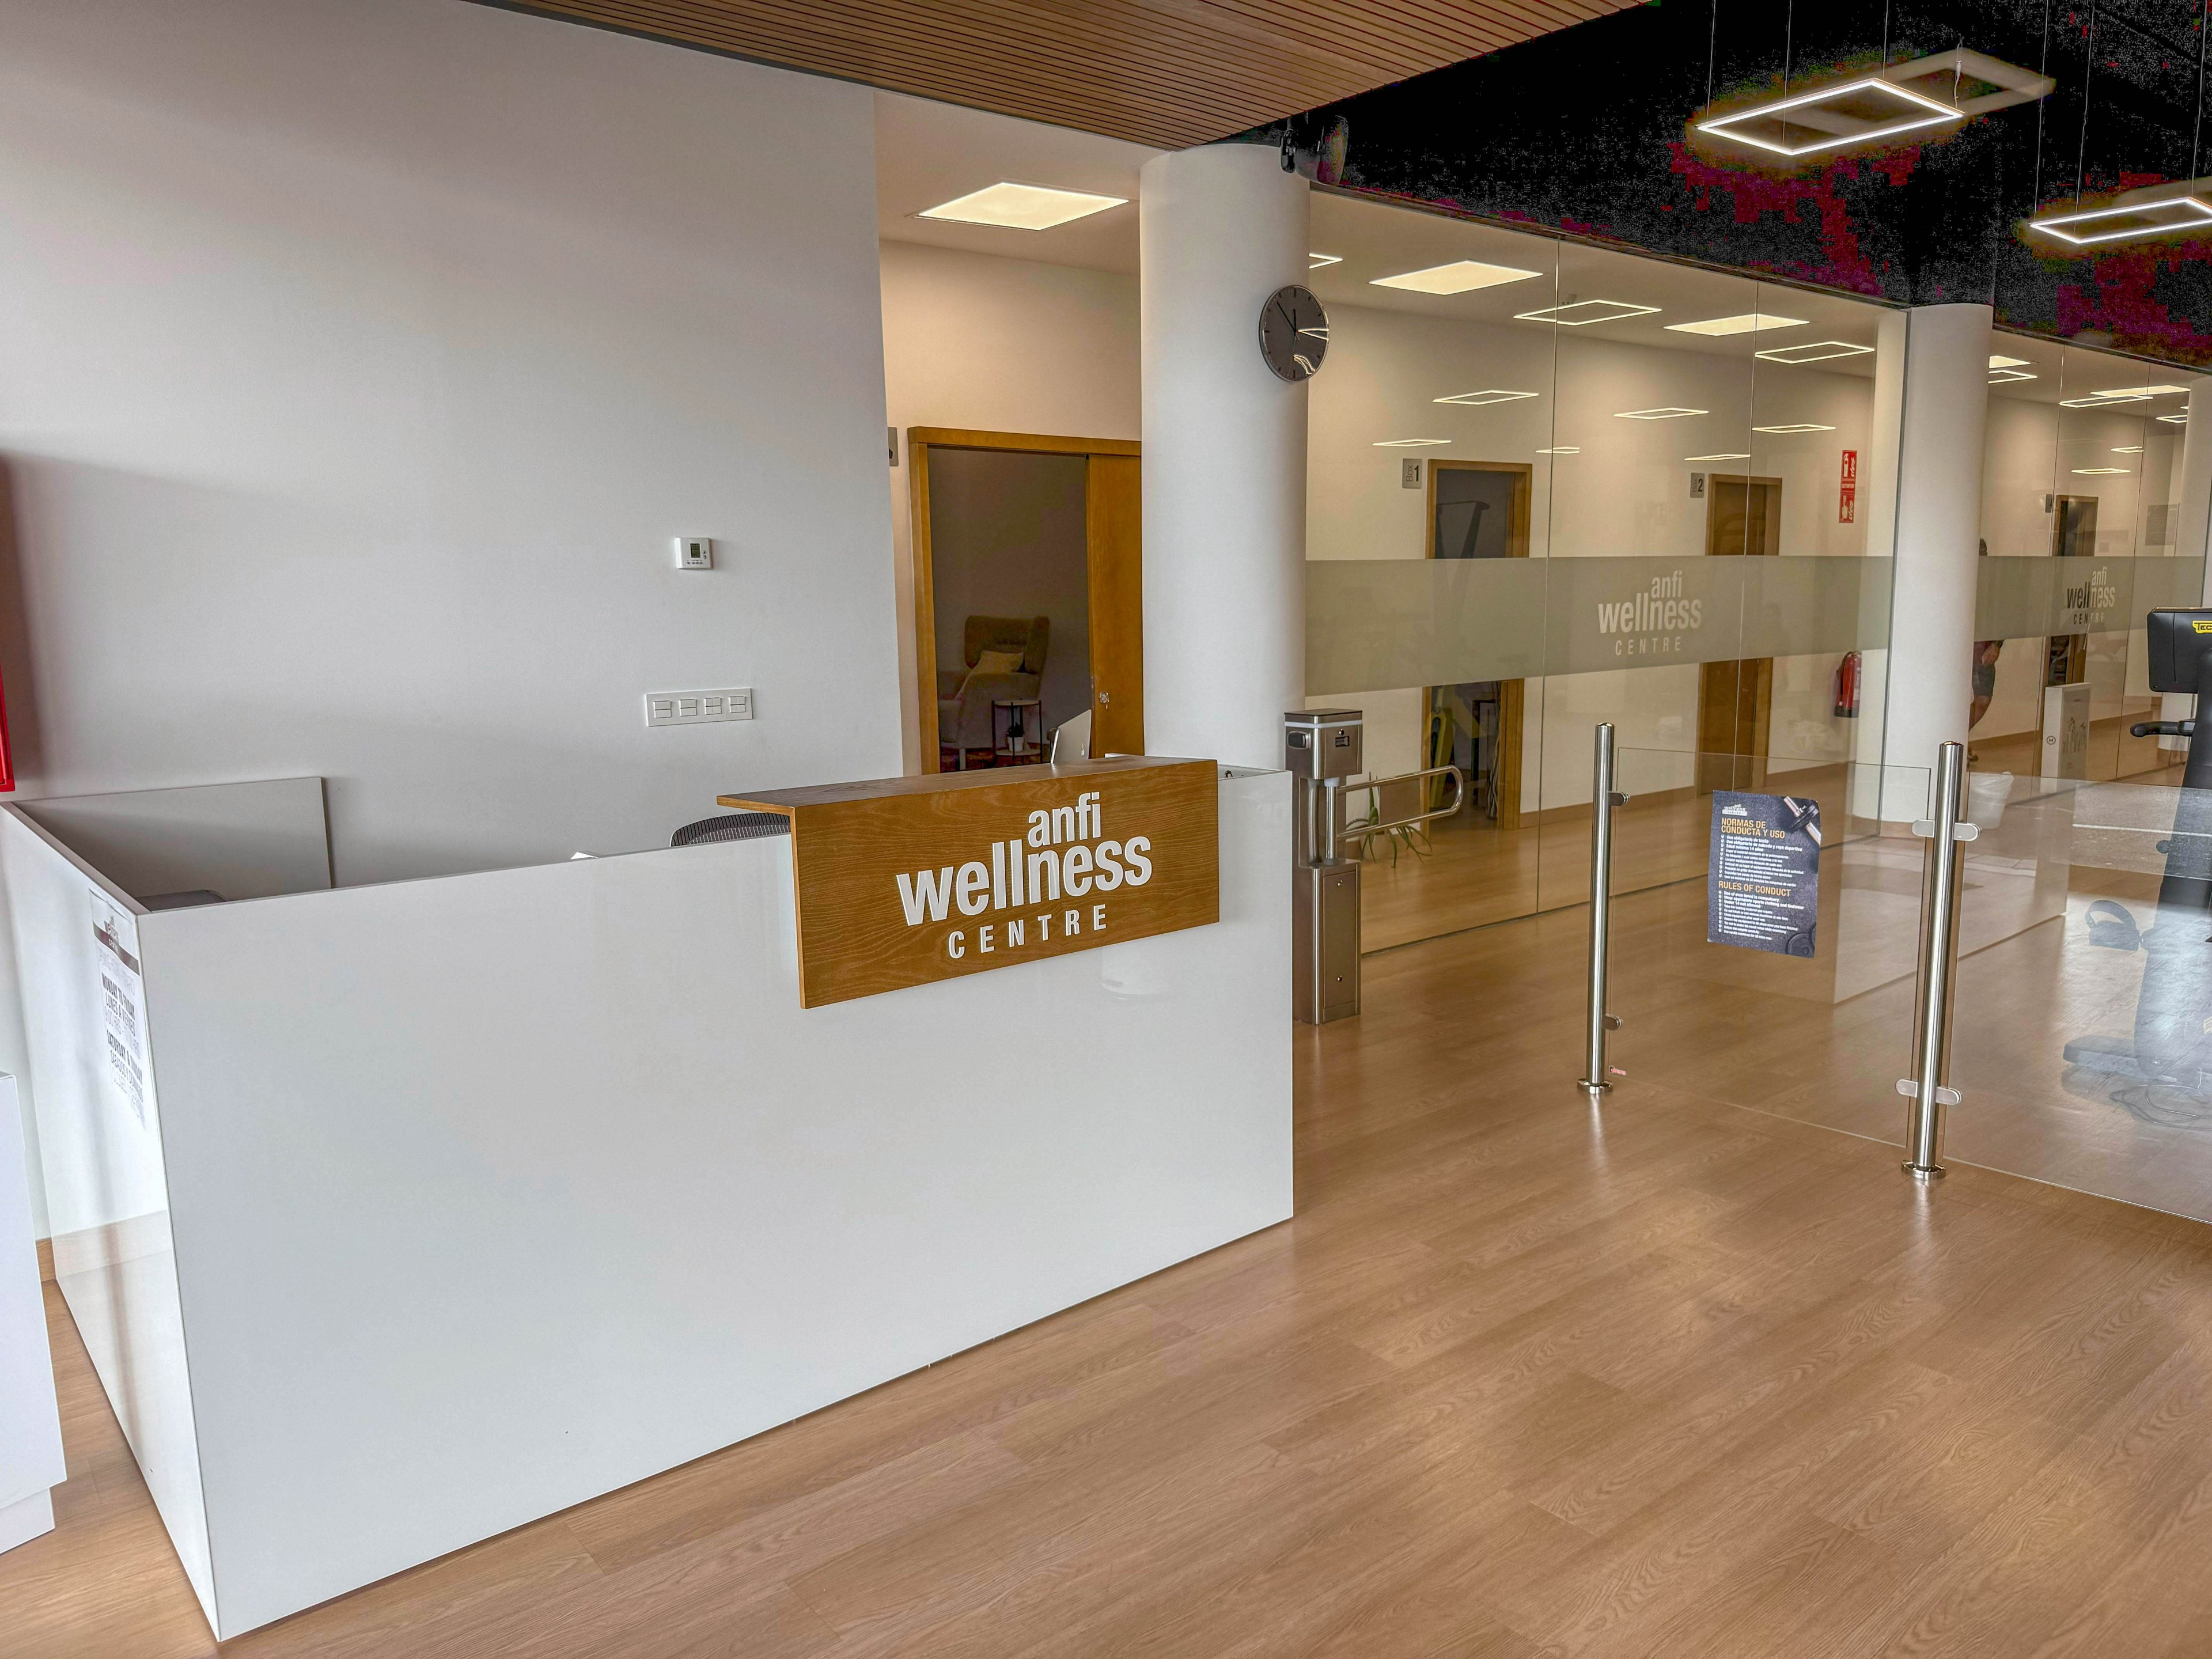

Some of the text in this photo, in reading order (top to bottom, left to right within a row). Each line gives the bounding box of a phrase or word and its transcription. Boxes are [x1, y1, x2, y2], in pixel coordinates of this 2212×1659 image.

[1414, 465, 1419, 482] 1
[1698, 478, 1703, 493] 2
[1651, 570, 1683, 599] anfi
[2092, 566, 2107, 586] anfi
[2067, 581, 2115, 609] wellness
[1598, 592, 1702, 634] wellness
[2073, 612, 2105, 625] CENTRE
[1615, 636, 1681, 656] CENTRE
[1027, 791, 1102, 848] anfi
[1721, 817, 1766, 829] NORMAS DE
[1721, 825, 1785, 839] CONDUCTA Y USO
[896, 835, 1153, 927] wellness
[1718, 880, 1742, 891] RULES
[1744, 884, 1753, 892] OF
[1755, 885, 1791, 897] CONDUCT
[948, 903, 1107, 959] CENTRE
